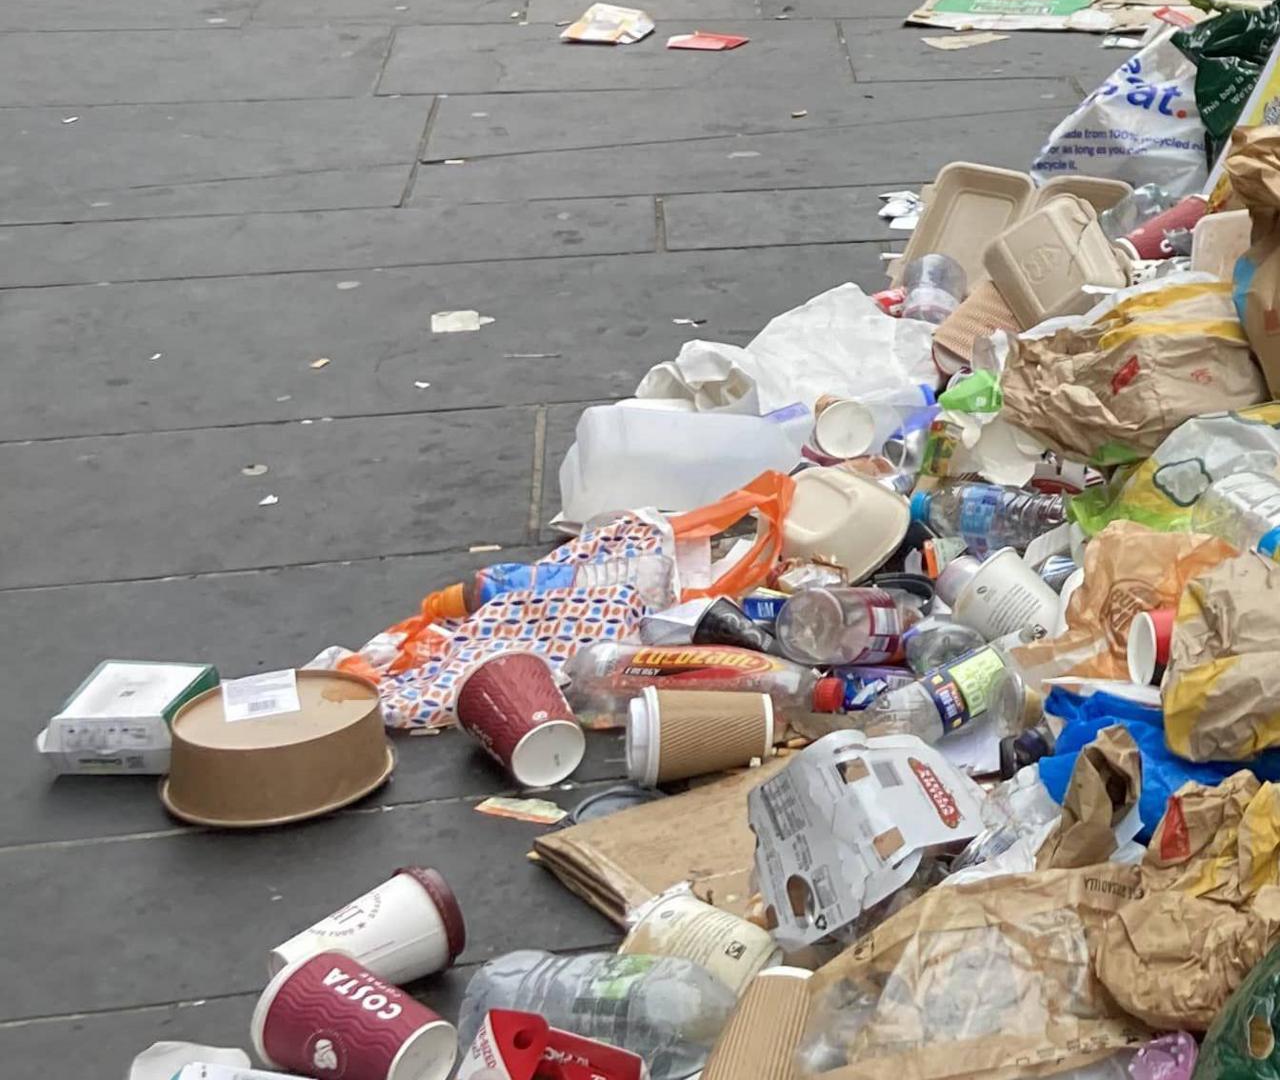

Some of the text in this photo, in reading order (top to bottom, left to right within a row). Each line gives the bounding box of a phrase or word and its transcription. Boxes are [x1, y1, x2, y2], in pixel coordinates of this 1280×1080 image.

[1203, 75, 1245, 116] This bag is
[1064, 129, 1083, 139] ade
[1074, 145, 1095, 158] long
[322, 966, 403, 1020] COSTA
